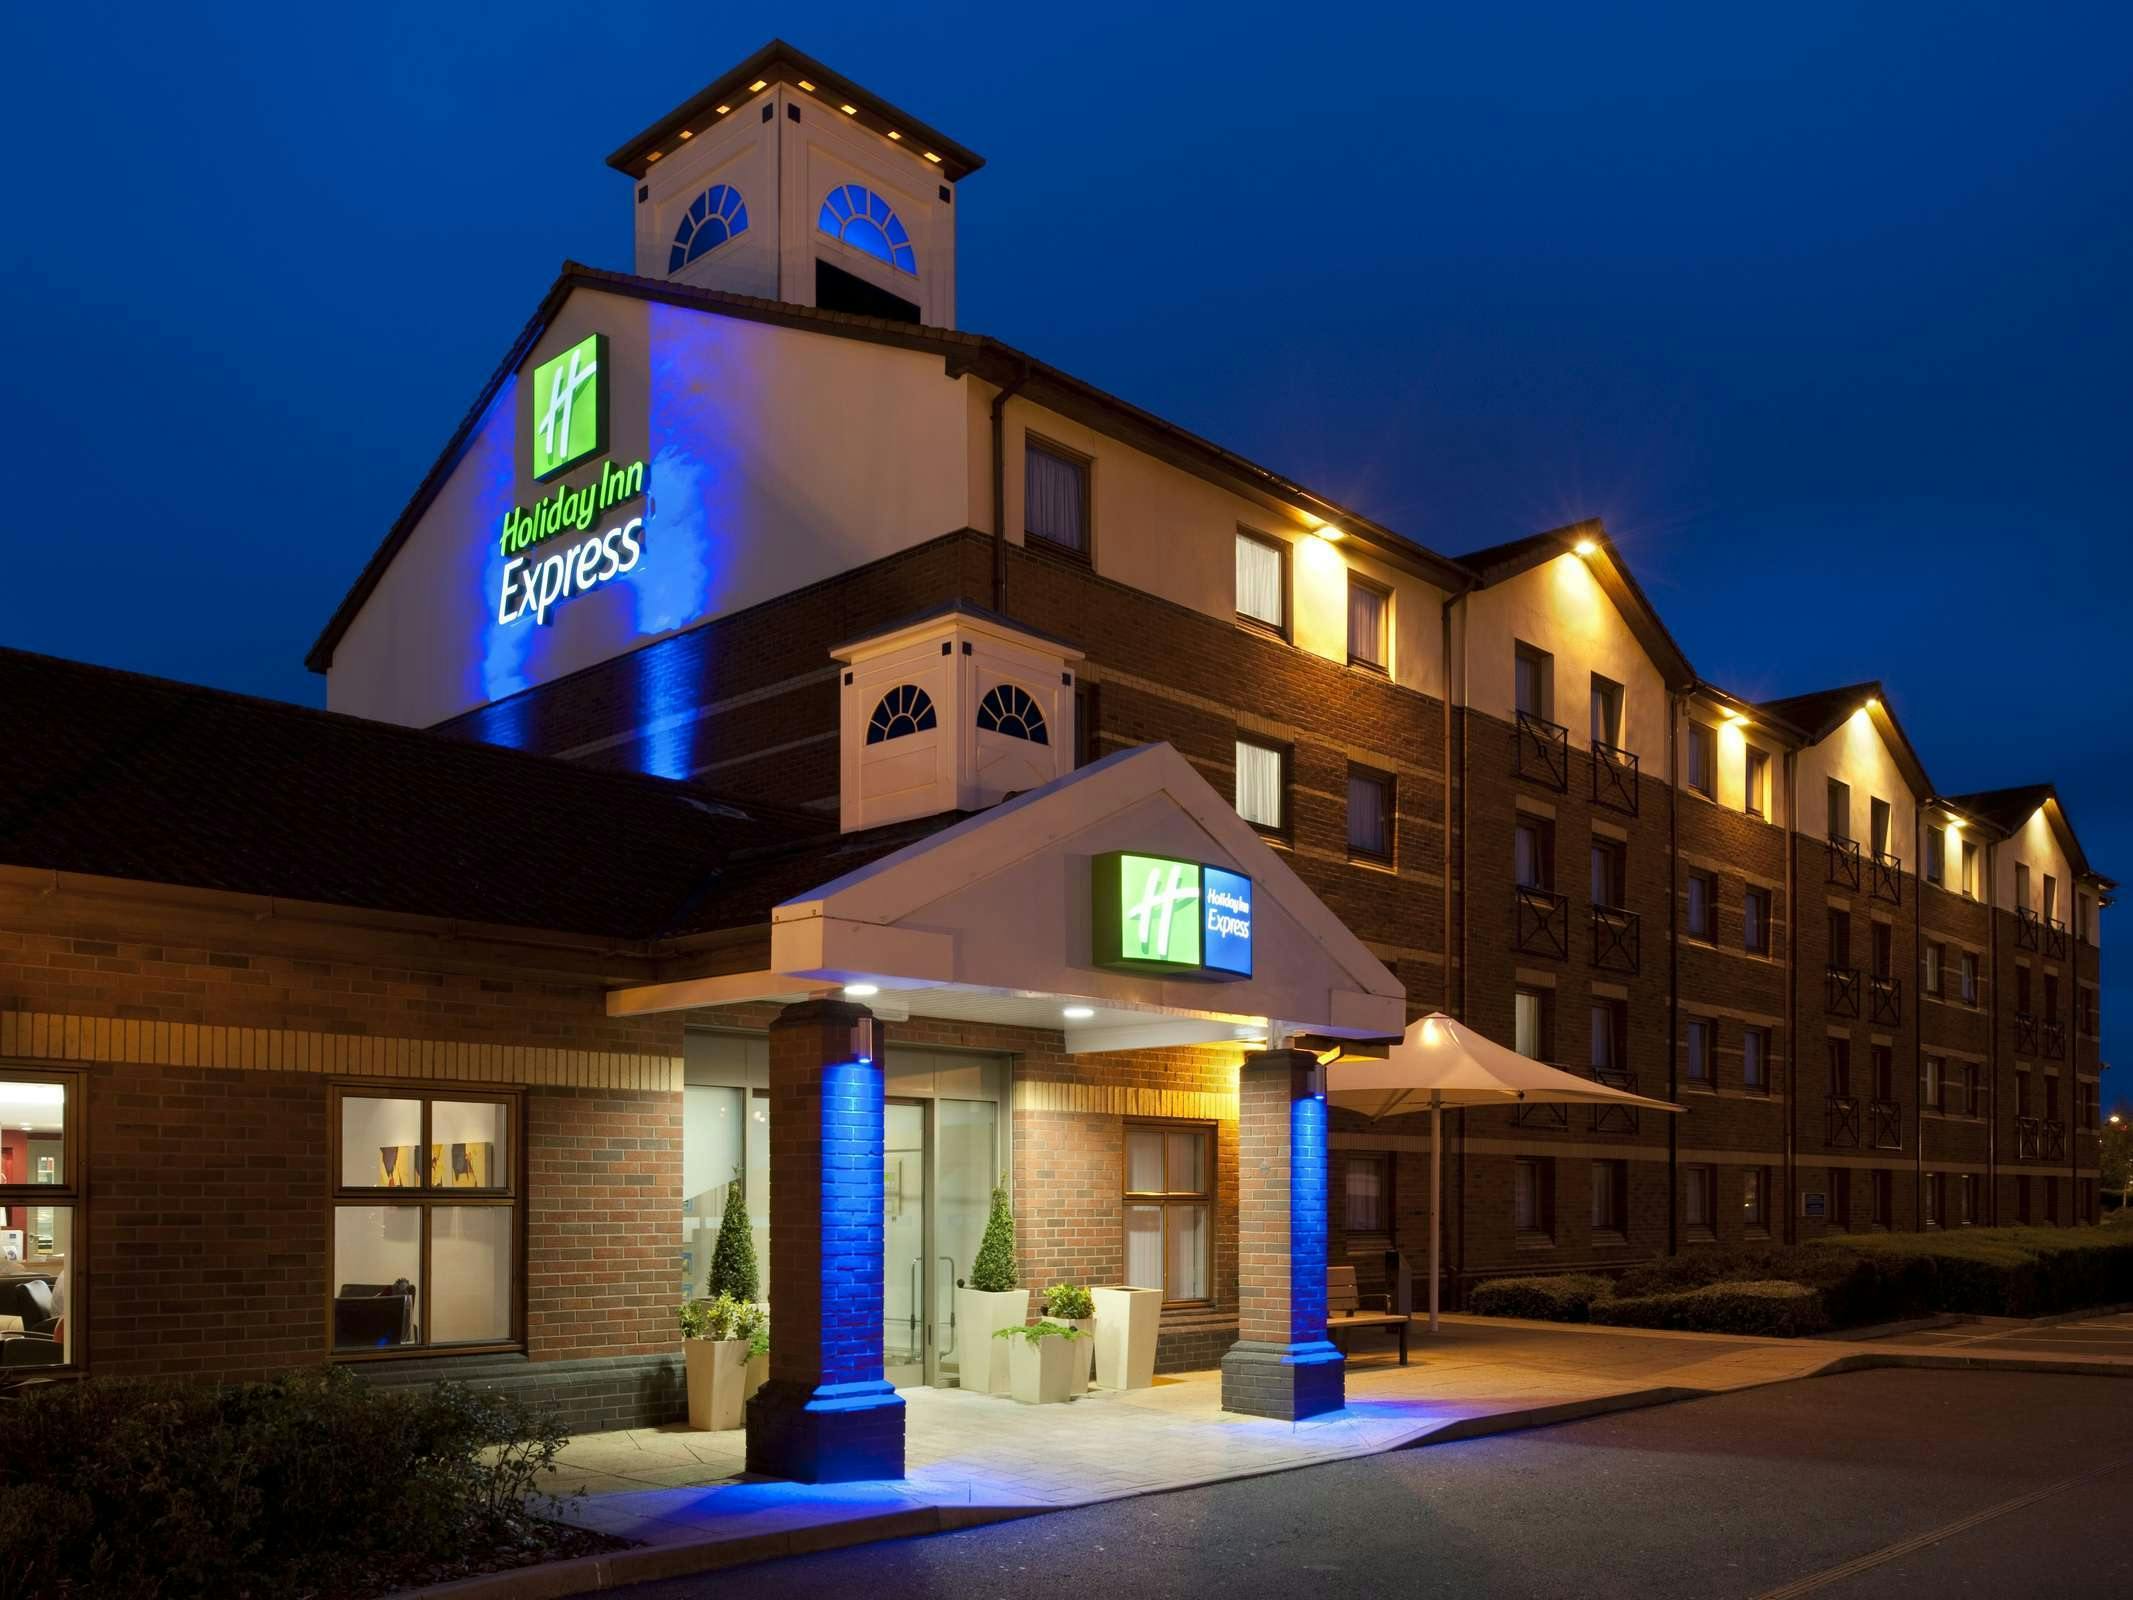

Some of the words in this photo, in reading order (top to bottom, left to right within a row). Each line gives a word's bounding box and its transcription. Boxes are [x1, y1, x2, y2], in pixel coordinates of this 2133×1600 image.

[500, 484, 597, 557] Holiday
[600, 460, 644, 509] Inn
[499, 517, 643, 625] Express
[1207, 908, 1250, 938] Express
